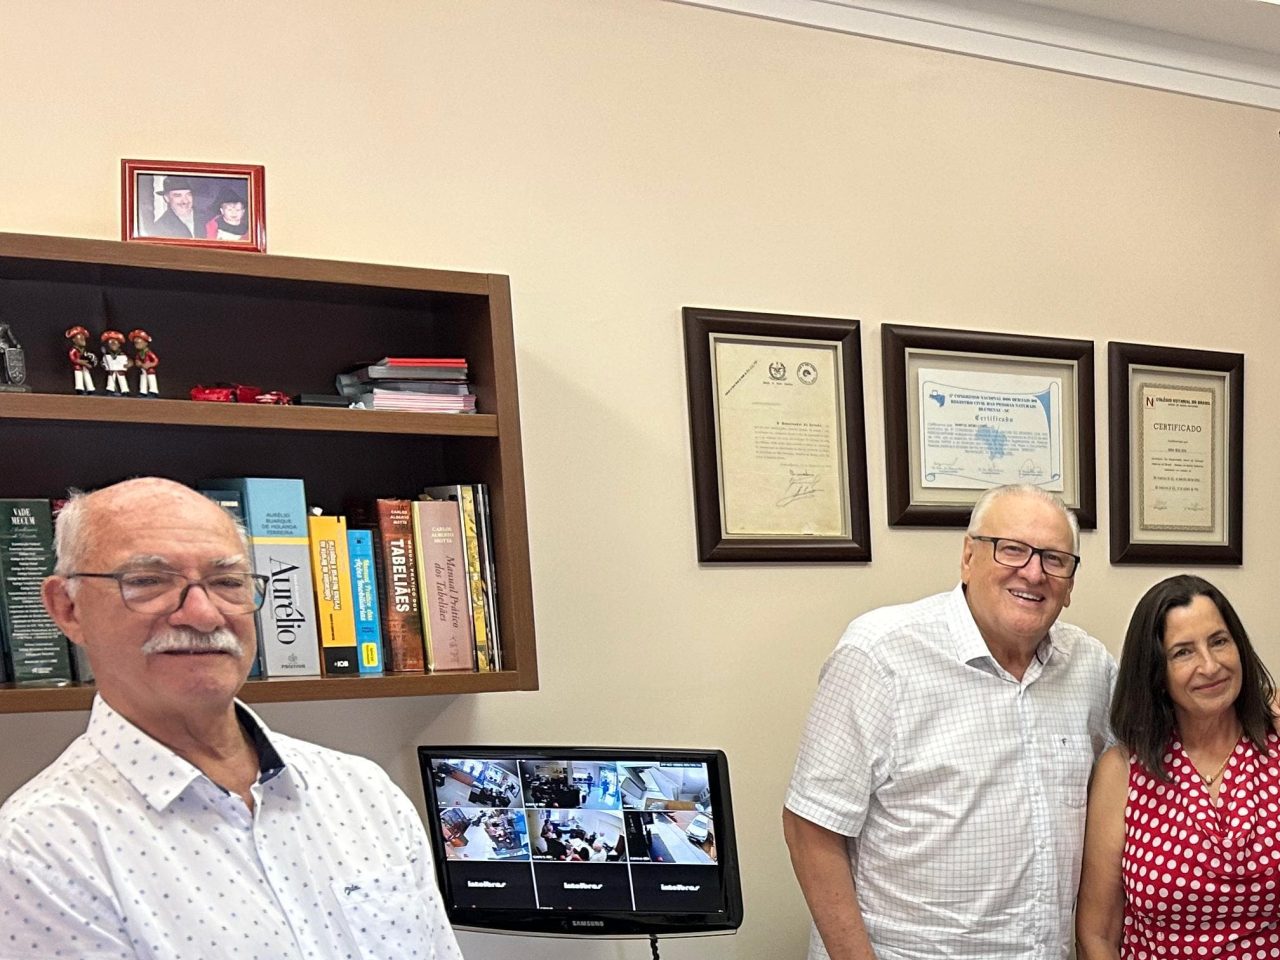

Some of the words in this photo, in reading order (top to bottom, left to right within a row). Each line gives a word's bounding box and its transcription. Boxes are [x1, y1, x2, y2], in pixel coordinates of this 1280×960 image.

[1154, 422, 1202, 432] CERTIFICADO
[11, 516, 35, 525] MECUM
[13, 508, 31, 516] VADE
[390, 539, 410, 613] TABELIÃES
[434, 562, 442, 578] dos
[446, 555, 458, 594] Manual
[269, 556, 306, 644] Aurélio
[436, 580, 448, 622] Tabeliães
[449, 595, 460, 628] Prático
